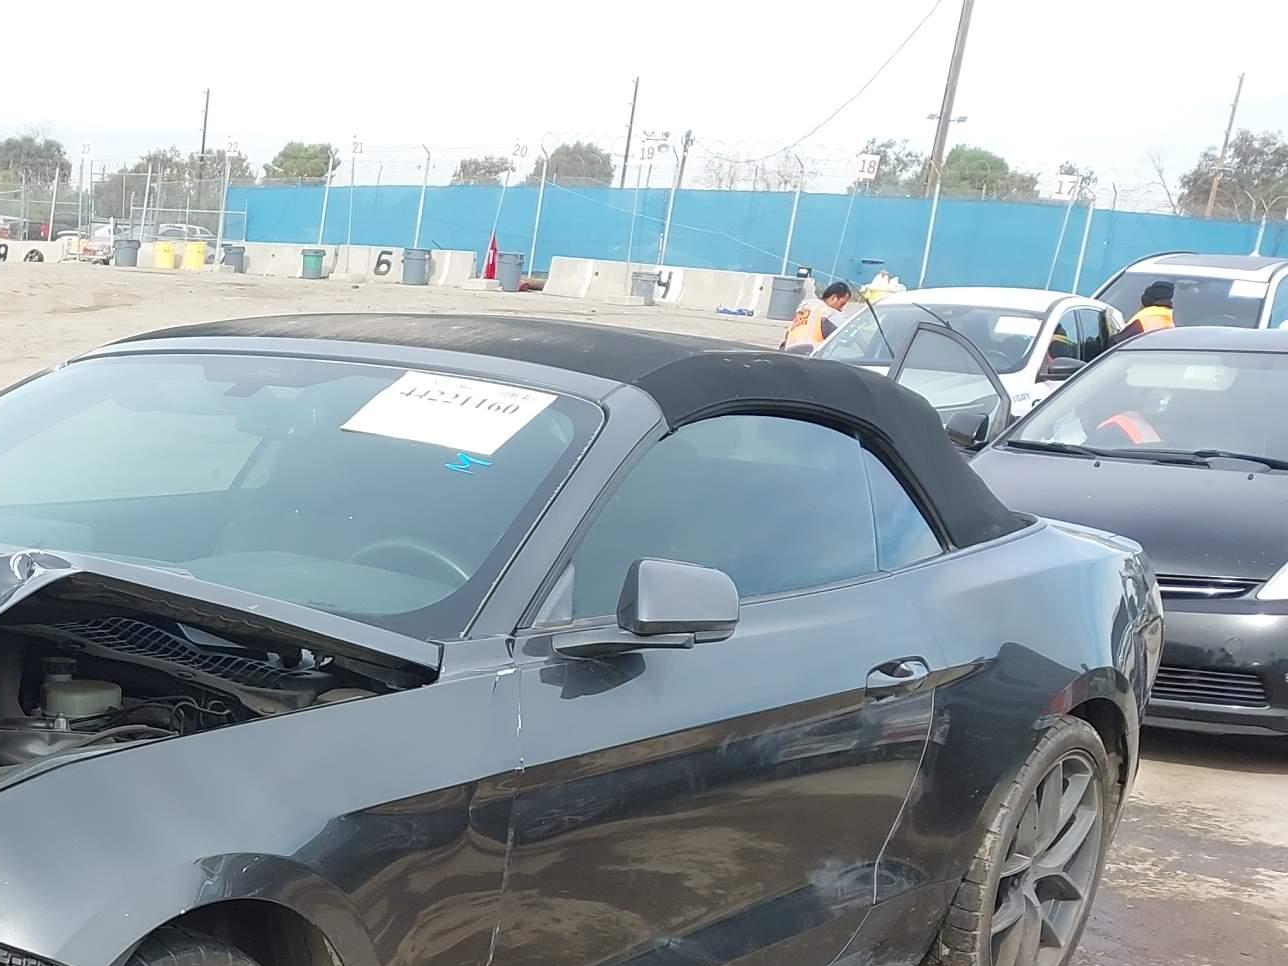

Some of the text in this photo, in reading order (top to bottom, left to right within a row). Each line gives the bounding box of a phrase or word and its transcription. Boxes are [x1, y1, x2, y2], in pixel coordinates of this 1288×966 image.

[227, 141, 239, 153] 22
[353, 142, 364, 154] 21
[512, 143, 528, 158] 20
[639, 146, 655, 161] 19
[858, 159, 877, 175] 18
[1055, 179, 1078, 196] 17
[373, 250, 394, 276] 6
[400, 387, 521, 416] 44221160
